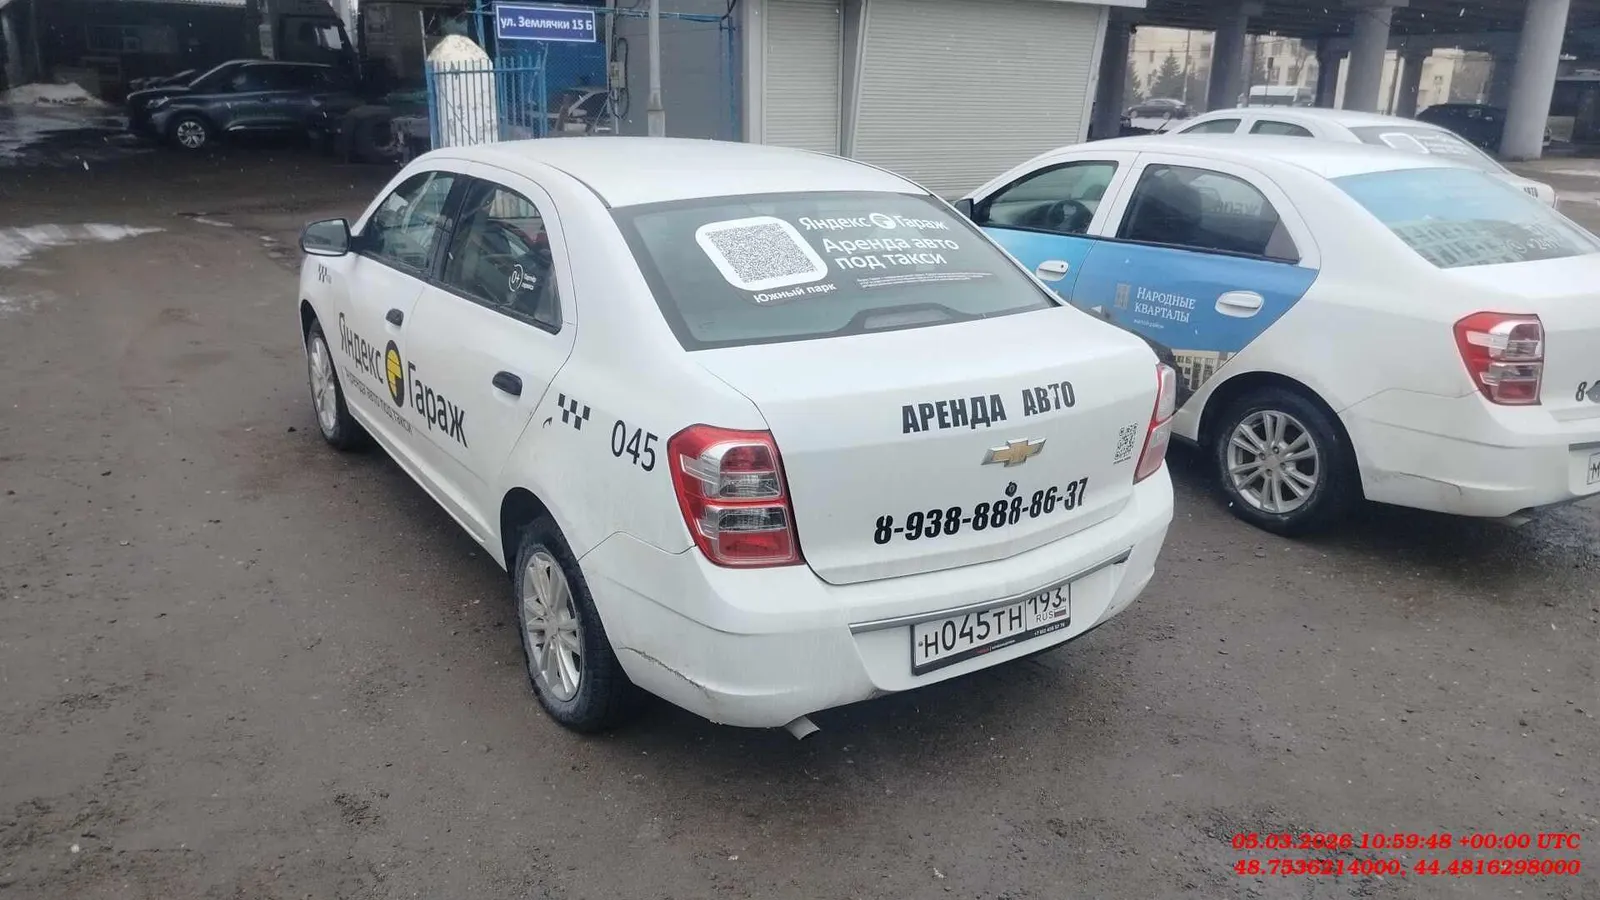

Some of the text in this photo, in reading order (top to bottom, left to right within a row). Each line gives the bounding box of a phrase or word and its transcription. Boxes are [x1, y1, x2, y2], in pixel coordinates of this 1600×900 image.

[500, 16, 593, 31] ул. Землячки 15 Б
[799, 215, 950, 231] Яндекс Гараж
[822, 237, 960, 255] Аренда авто
[834, 251, 948, 270] под такси
[753, 283, 837, 303] Южный парк
[1136, 286, 1197, 310] НАРОДНЫЕ
[1134, 302, 1190, 323] КВАРТАЛЫ
[338, 312, 468, 448] Яндекс Гараж
[901, 380, 1076, 435] АРЕНДА АВТО
[611, 419, 659, 472] 045
[873, 476, 1089, 545] 8-938-888-86-37
[1036, 611, 1054, 623] RUS
